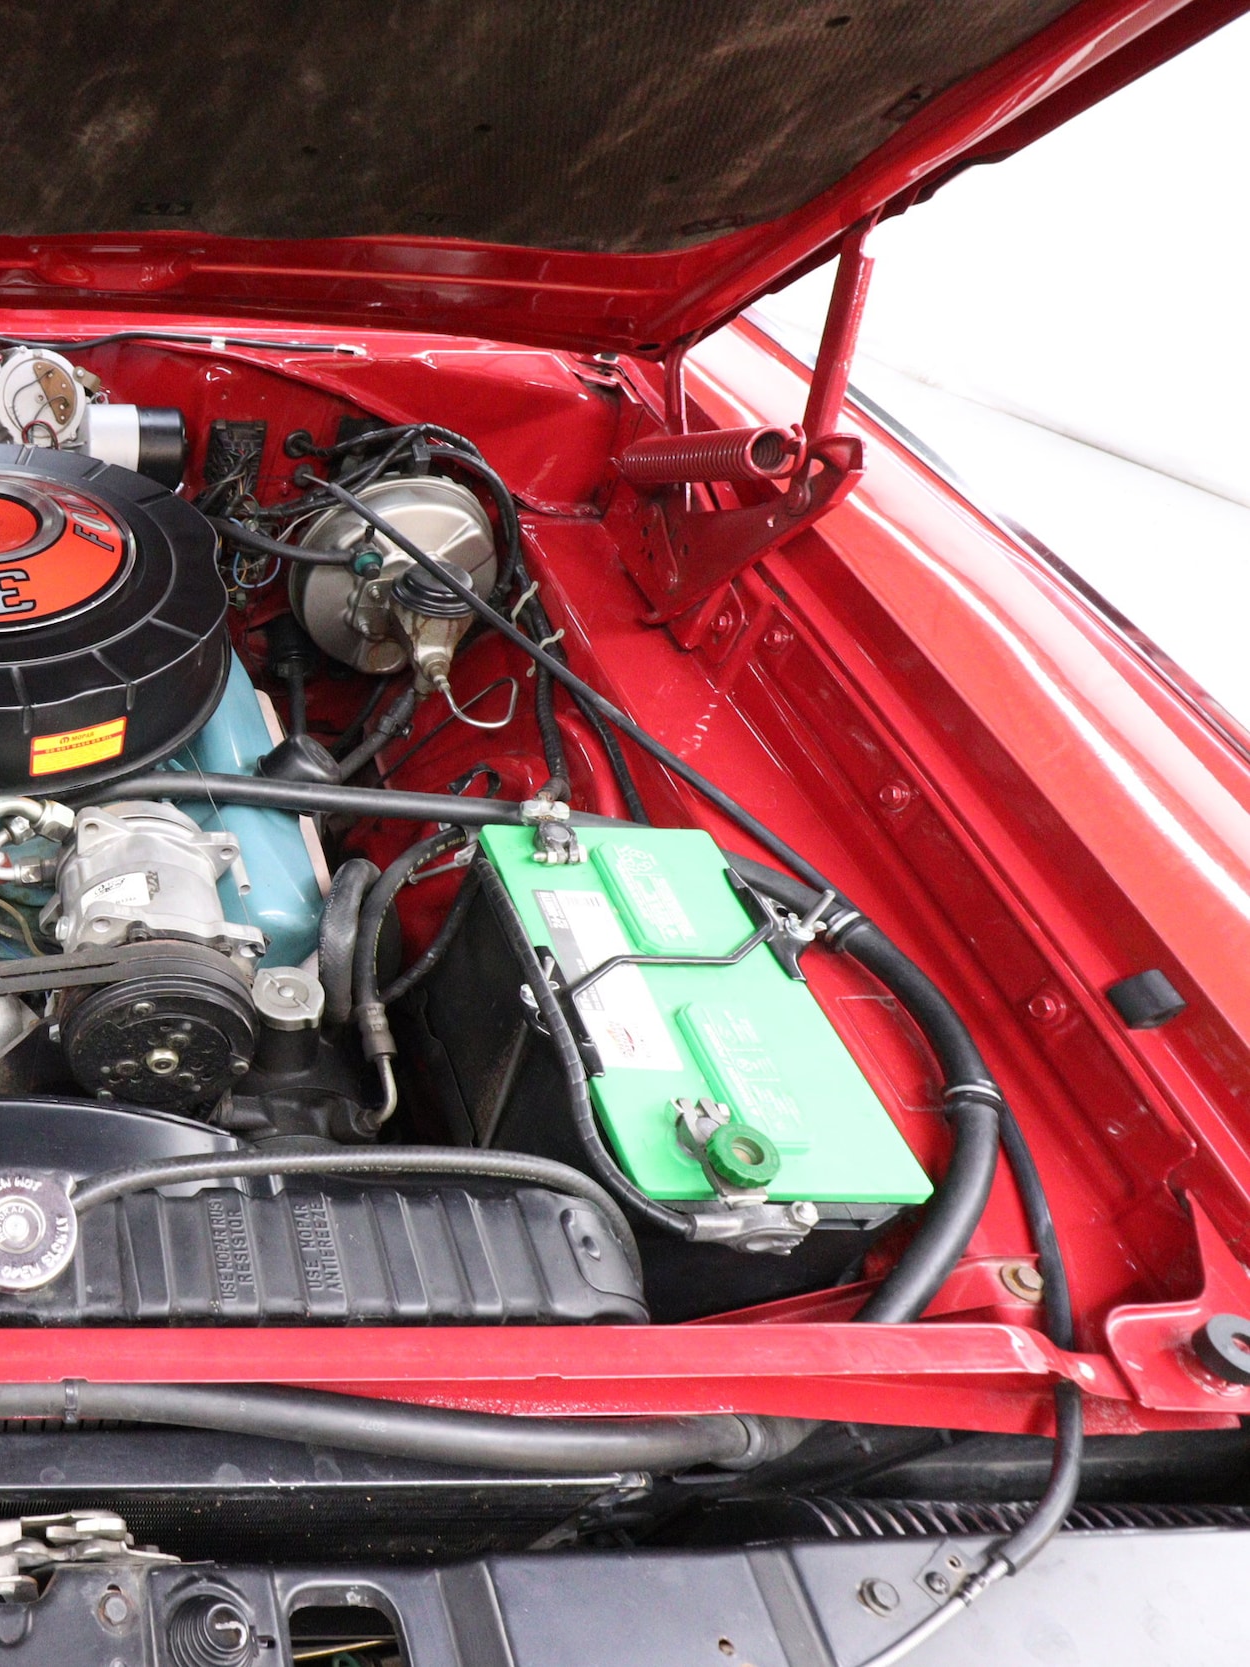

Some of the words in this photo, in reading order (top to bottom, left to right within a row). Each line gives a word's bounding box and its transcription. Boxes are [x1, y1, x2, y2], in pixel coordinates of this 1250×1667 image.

[14, 1176, 43, 1192] HOT
[207, 1198, 227, 1228] RUST
[293, 1204, 317, 1251] MOPAR
[212, 1230, 233, 1273] MOPAR
[227, 1210, 254, 1285] RESISTOR
[310, 1202, 344, 1294] ANTIFREEZE
[219, 1274, 238, 1302] USE
[304, 1260, 324, 1291] USE
